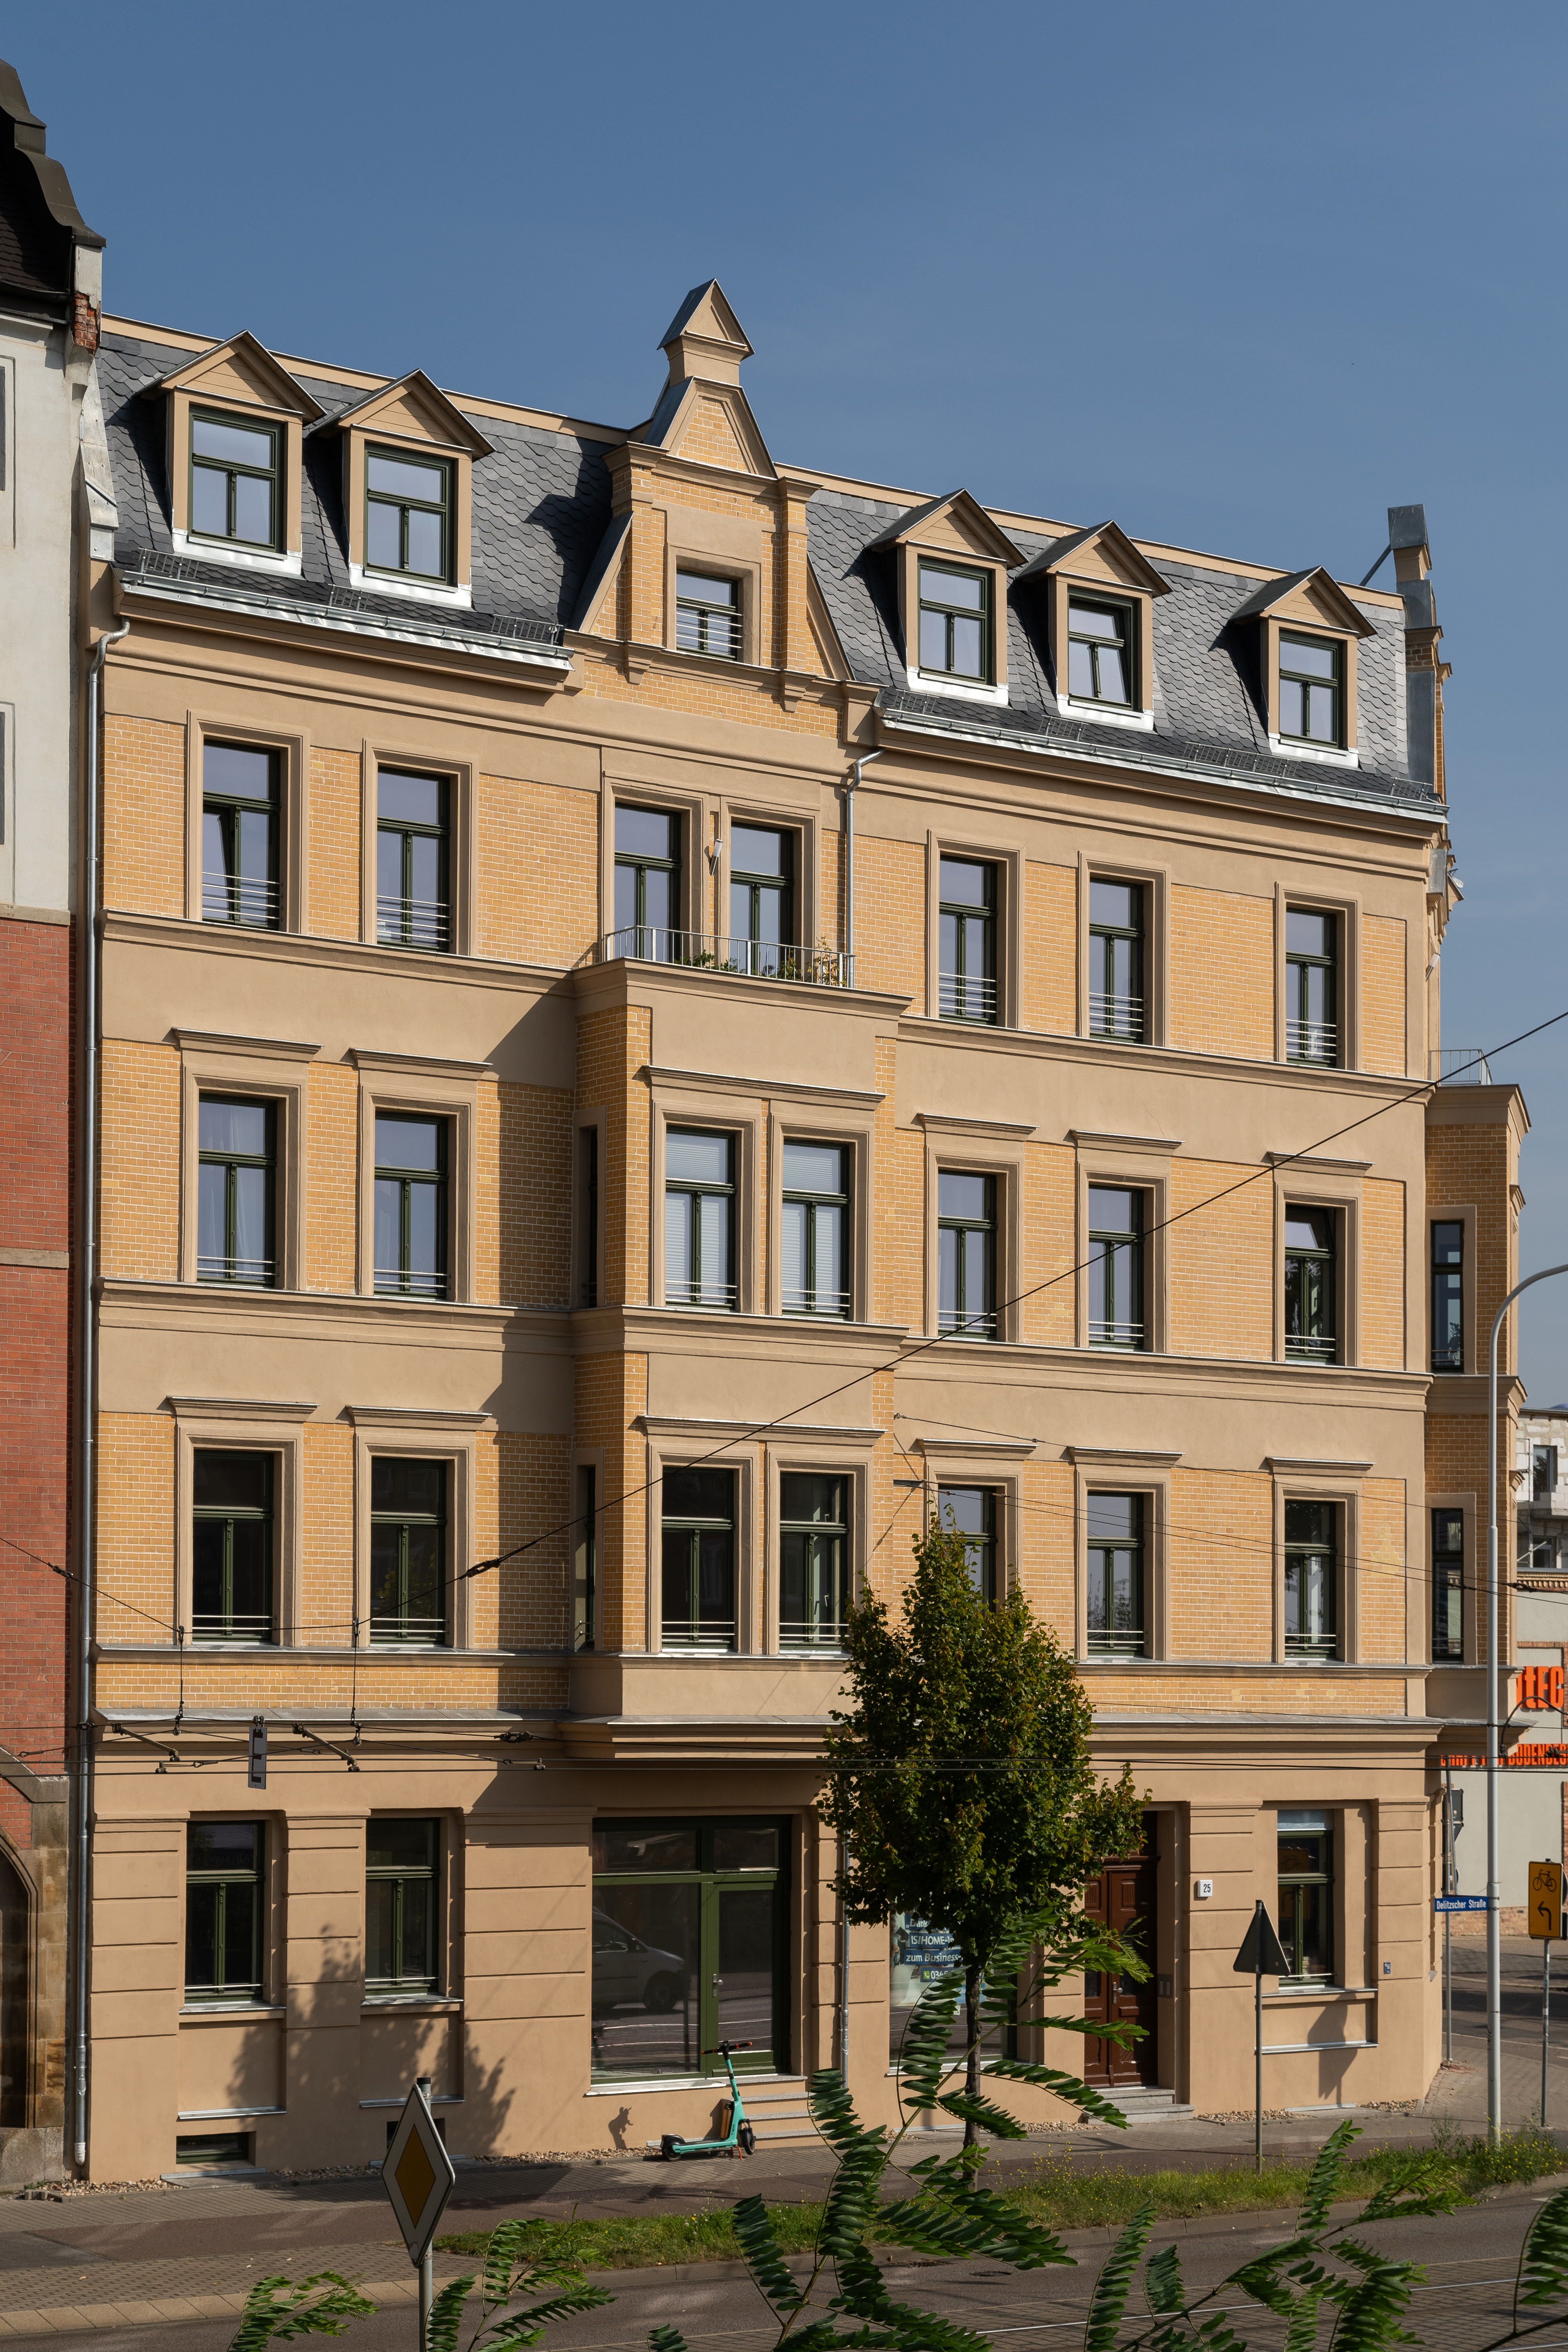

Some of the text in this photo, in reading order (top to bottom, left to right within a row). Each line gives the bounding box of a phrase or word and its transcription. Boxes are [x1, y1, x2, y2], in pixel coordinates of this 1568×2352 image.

[1203, 1884, 1211, 1893] 25
[1436, 1899, 1486, 1909] Delitzscher Straße
[924, 1953, 963, 1962] Business-
